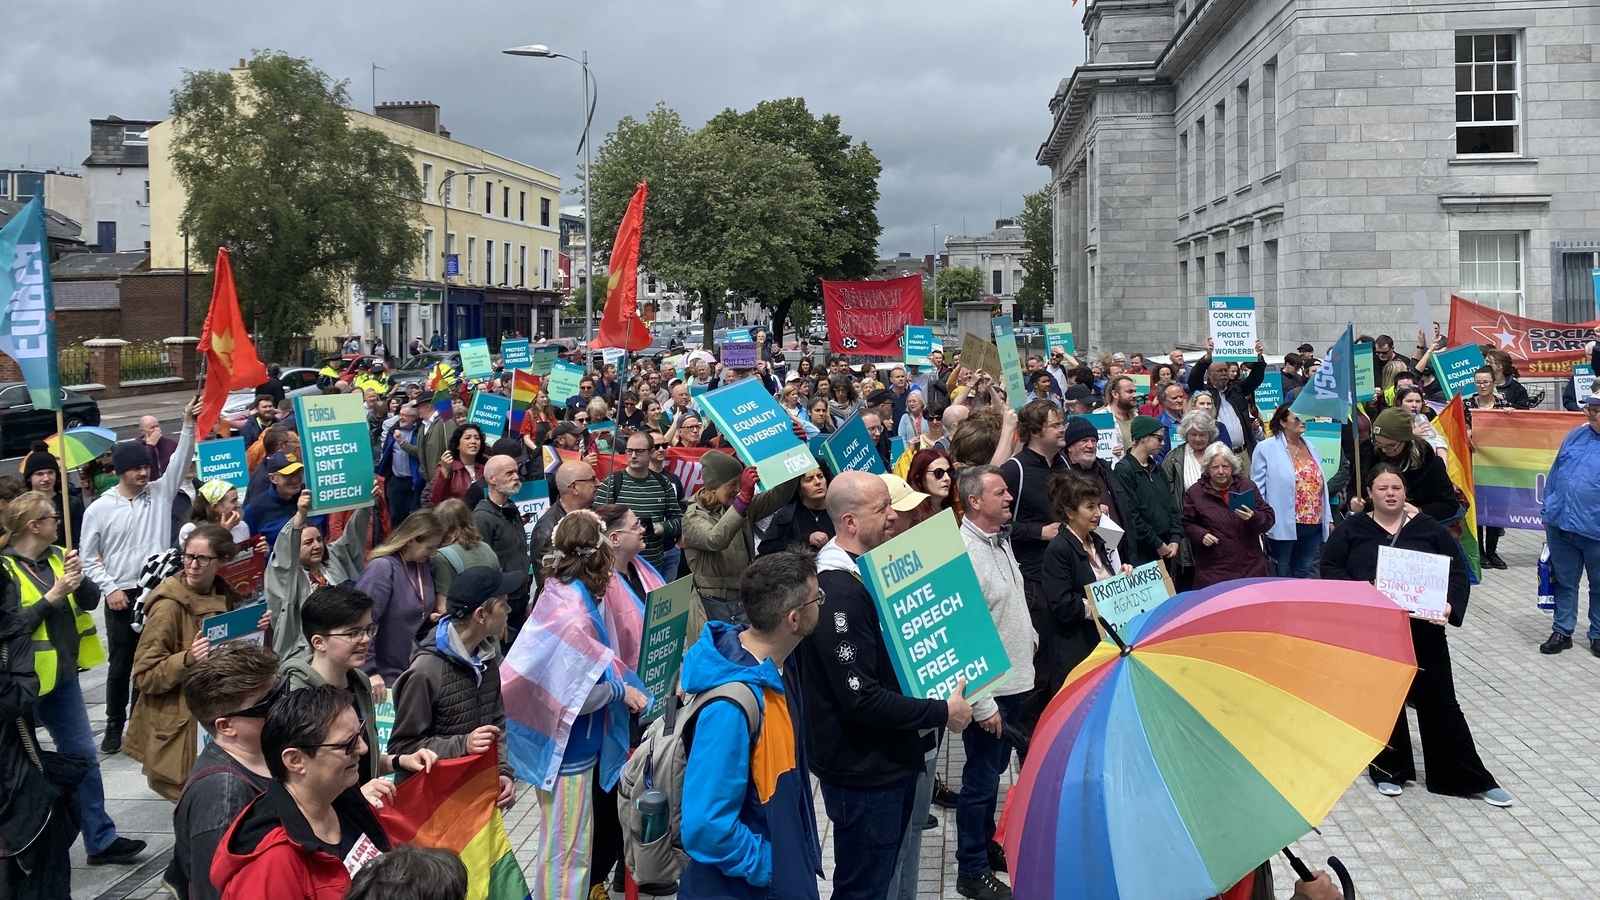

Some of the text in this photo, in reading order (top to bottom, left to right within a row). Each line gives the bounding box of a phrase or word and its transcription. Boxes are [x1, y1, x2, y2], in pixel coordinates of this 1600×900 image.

[1217, 331, 1250, 339] PROTECT
[1447, 365, 1480, 380] EQUALITY
[1451, 359, 1471, 370] LOVE
[308, 403, 336, 422] FÓRSA
[475, 410, 502, 420] EQUALITY
[731, 400, 759, 417] LOVE
[472, 417, 502, 428] DIVERSITY
[732, 409, 777, 433] EQUALITY
[311, 430, 341, 443] HATE
[741, 421, 788, 448] DIVERSITY
[314, 442, 358, 457] SPEECH
[842, 438, 859, 458] LOVE
[210, 452, 231, 462] LOVE
[316, 458, 344, 472] ISN'T
[783, 453, 813, 475] FÓRSA
[203, 461, 241, 473] EQUALITY
[203, 470, 243, 483] DIVERSITY
[318, 473, 346, 487] FREE
[319, 485, 362, 502] SPEECH
[523, 502, 545, 513] CITY
[1381, 547, 1437, 564] EDUCATION
[880, 549, 923, 589] FÓRSA
[1388, 559, 1426, 573] IS NOT
[1092, 565, 1163, 603] PROTECT WORKERS
[1379, 578, 1426, 594] STAND UP
[892, 582, 936, 619] HATE
[1113, 586, 1154, 615] AGAINST
[1402, 593, 1420, 604] THE
[652, 597, 672, 622] FÓRSA
[901, 592, 964, 641] SPEECH
[649, 626, 671, 647] HATE
[908, 626, 949, 663] ISN'T
[647, 638, 678, 665] SPEECH
[645, 662, 667, 683] ISN'T
[916, 648, 960, 686] FREE
[925, 656, 989, 700] SPEECH
